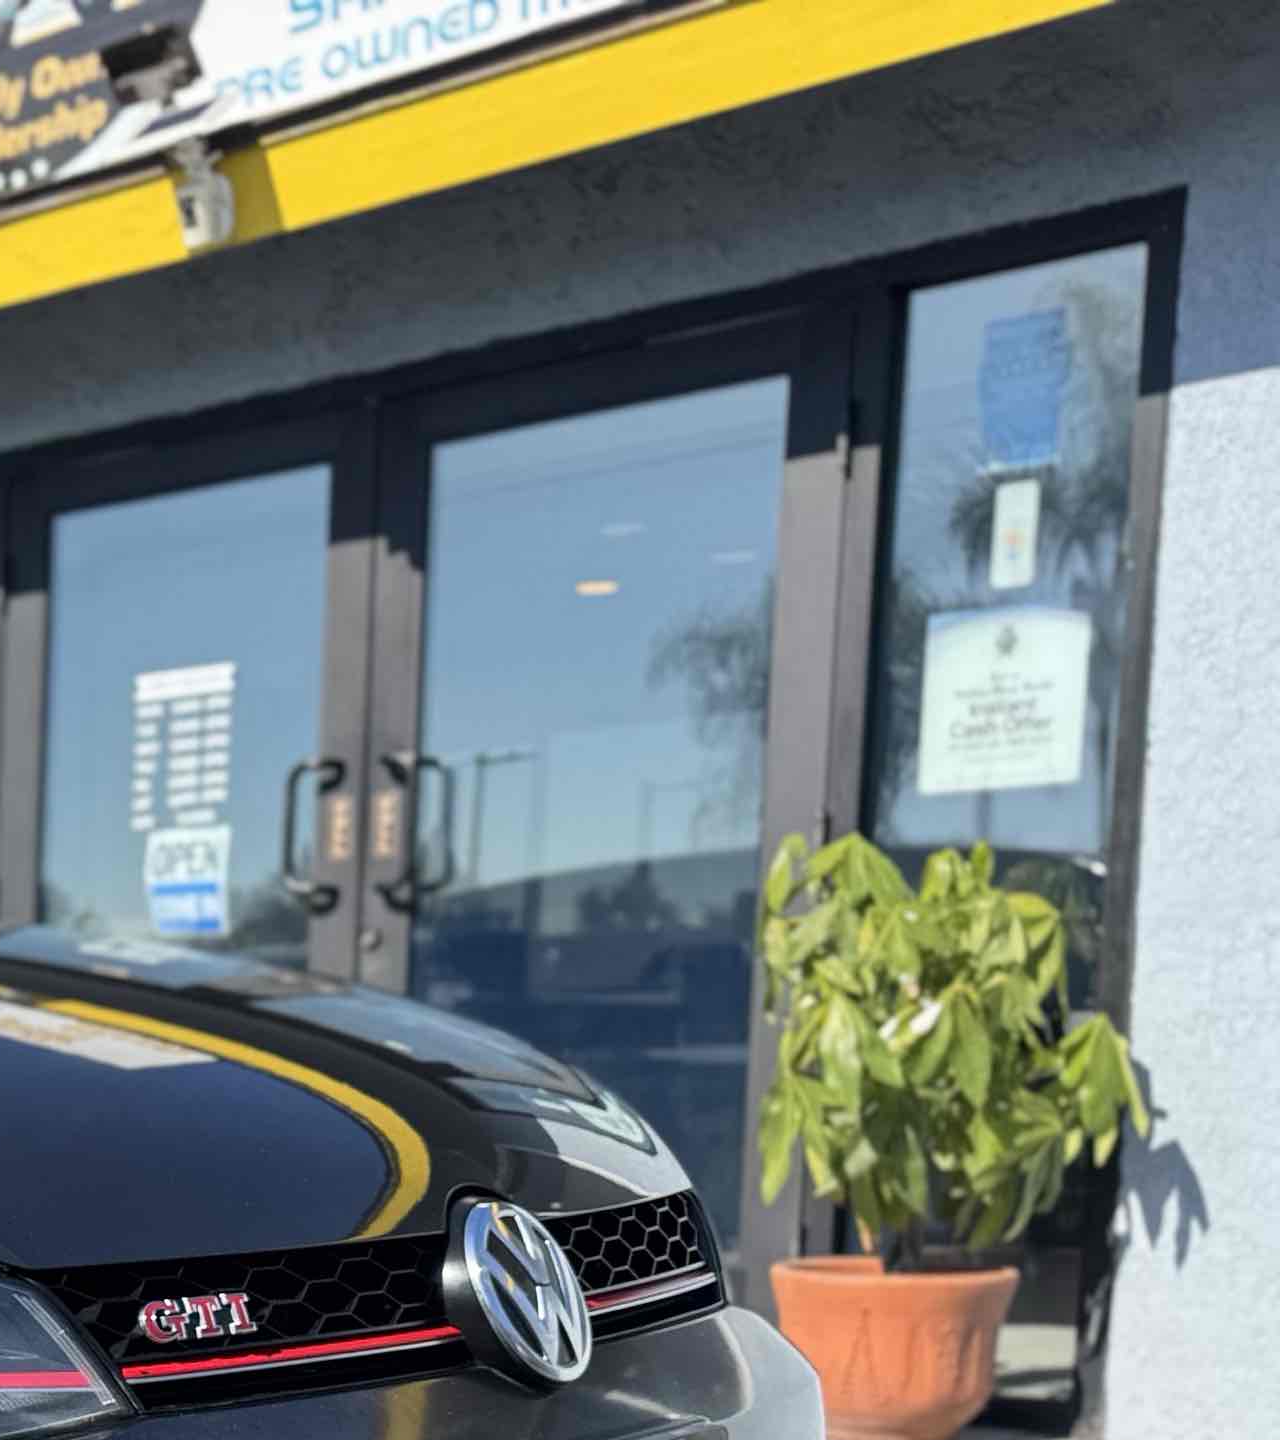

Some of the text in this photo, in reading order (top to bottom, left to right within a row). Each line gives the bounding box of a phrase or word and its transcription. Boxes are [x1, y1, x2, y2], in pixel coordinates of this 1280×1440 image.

[321, 3, 498, 79] OWNED
[151, 842, 220, 878] OPEN
[139, 1293, 258, 1344] GTI
